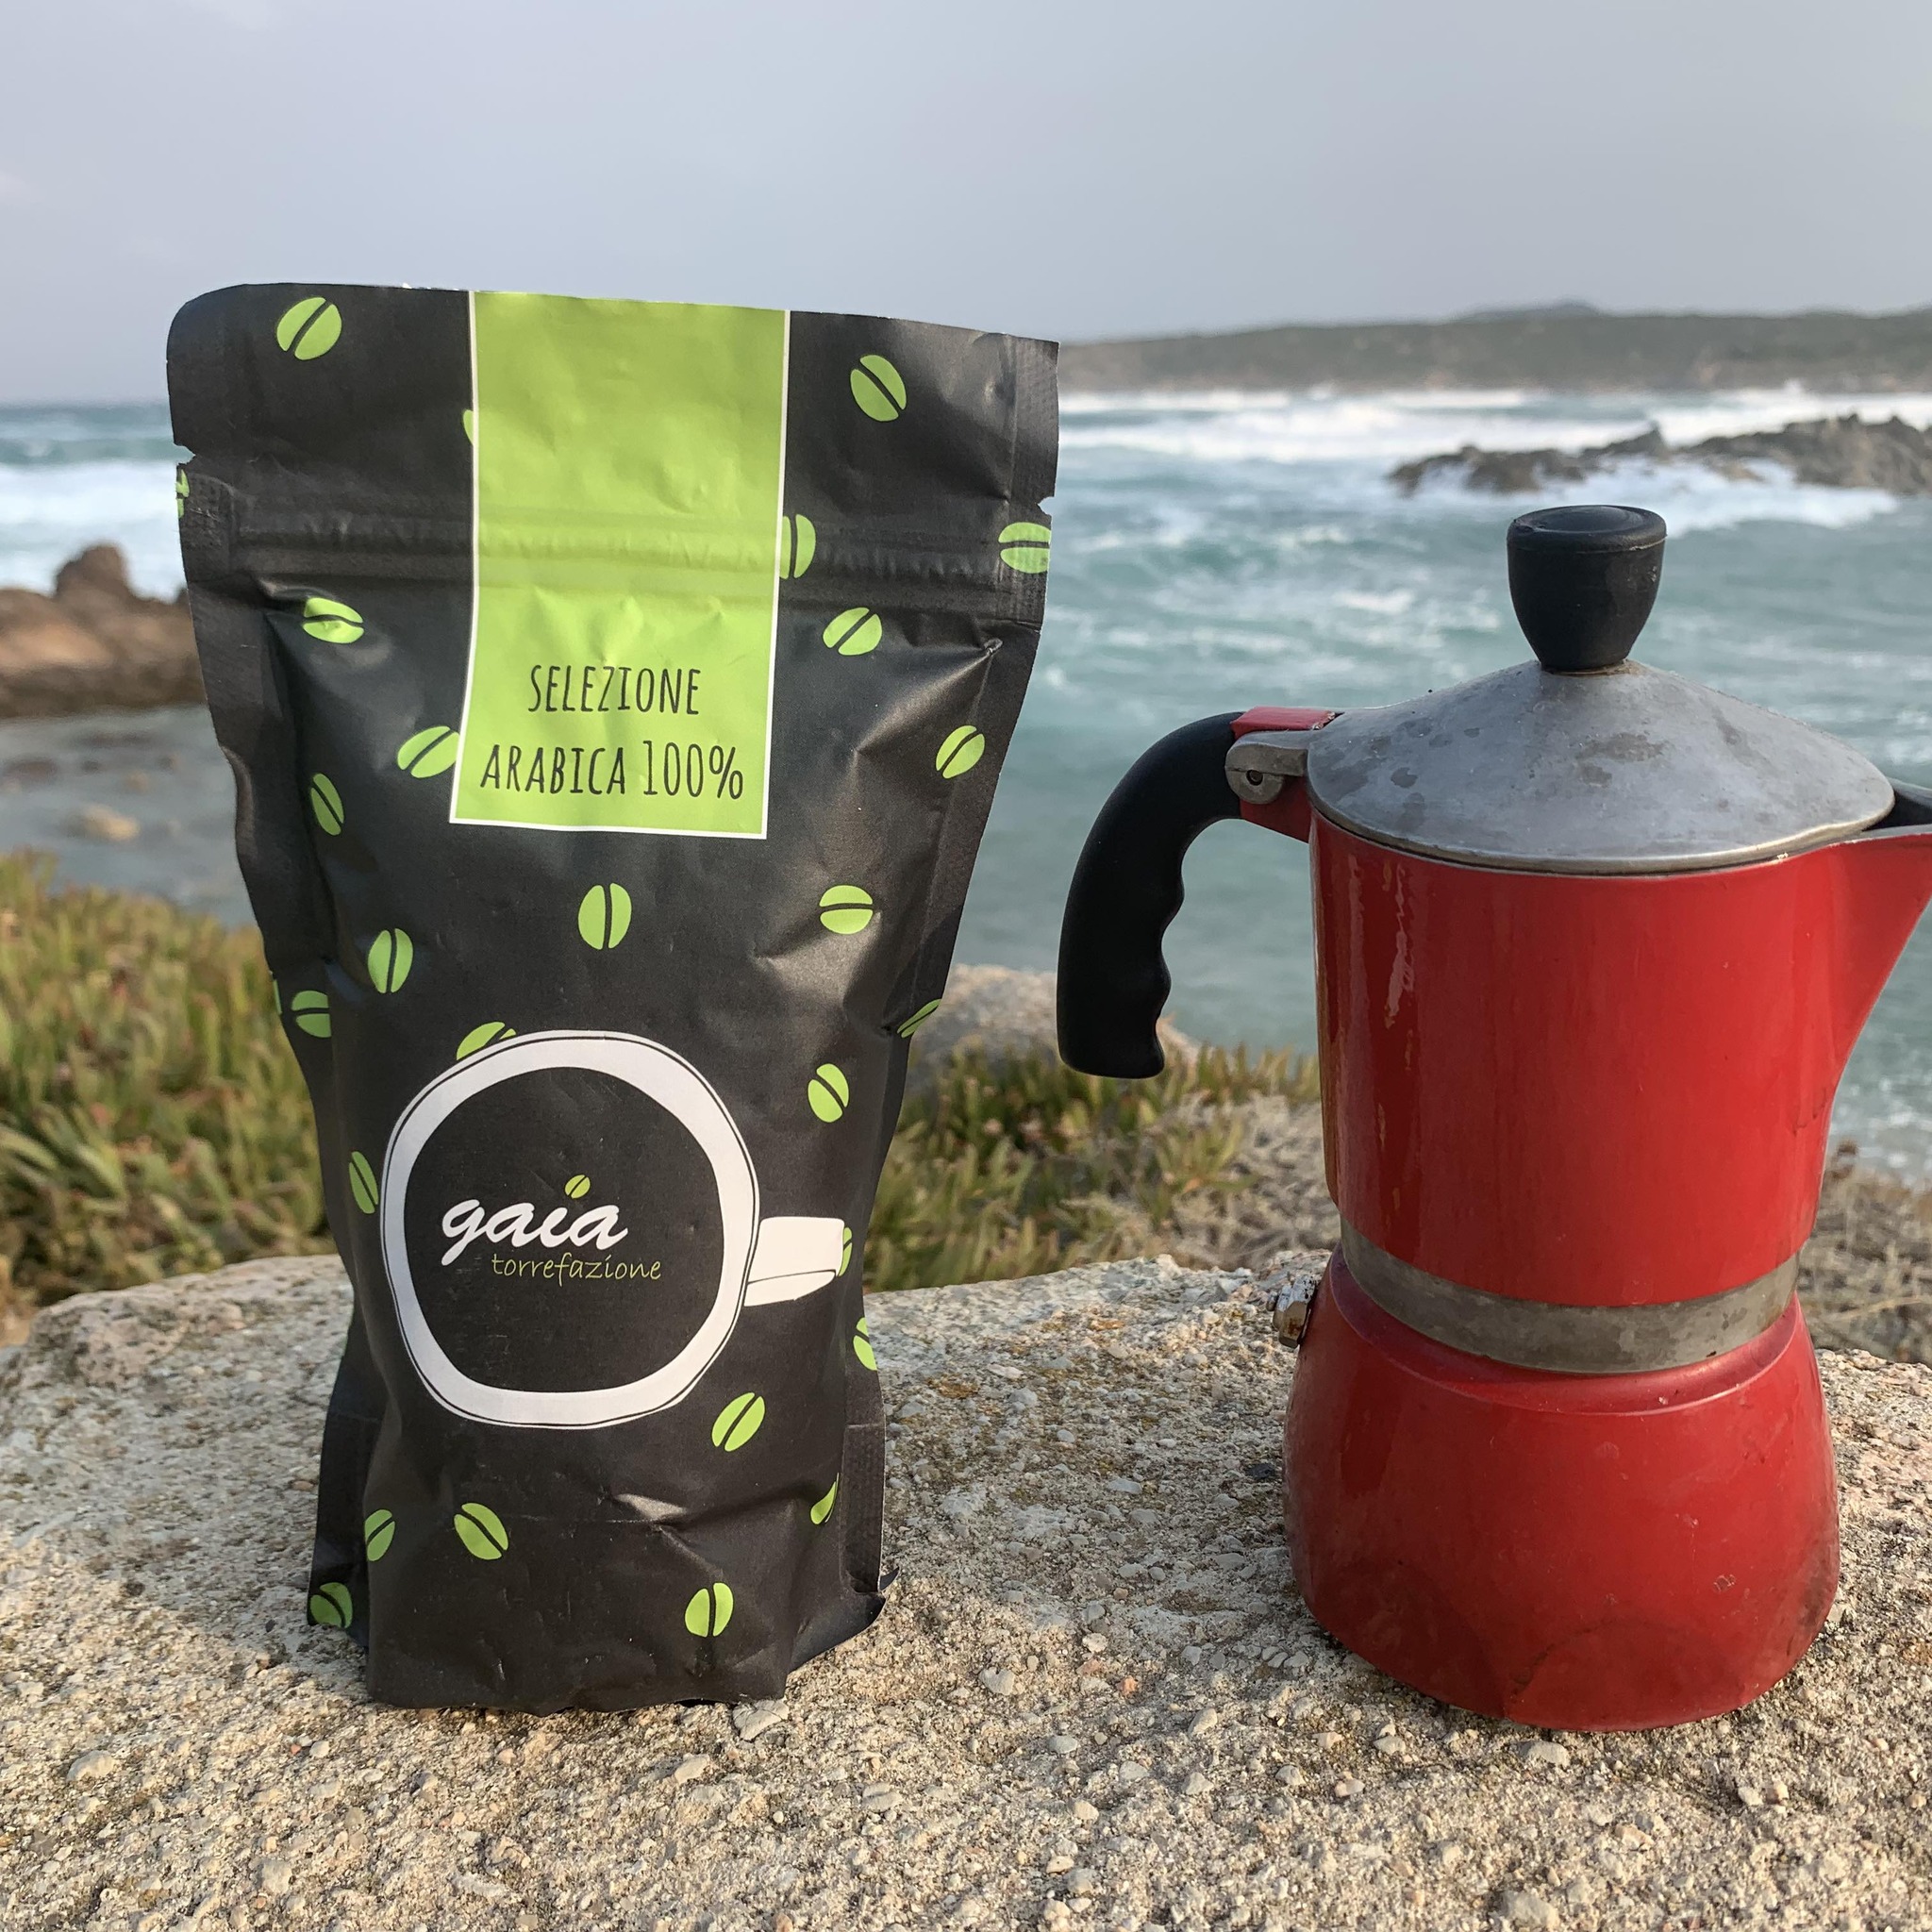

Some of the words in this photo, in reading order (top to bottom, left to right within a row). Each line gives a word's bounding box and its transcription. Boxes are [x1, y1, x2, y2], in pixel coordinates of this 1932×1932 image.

[527, 664, 701, 715] SELEZIONE
[479, 743, 626, 795] ARABICA
[642, 740, 744, 800] 100%
[441, 1174, 629, 1267] gaia
[491, 1252, 662, 1288] torrefazione
